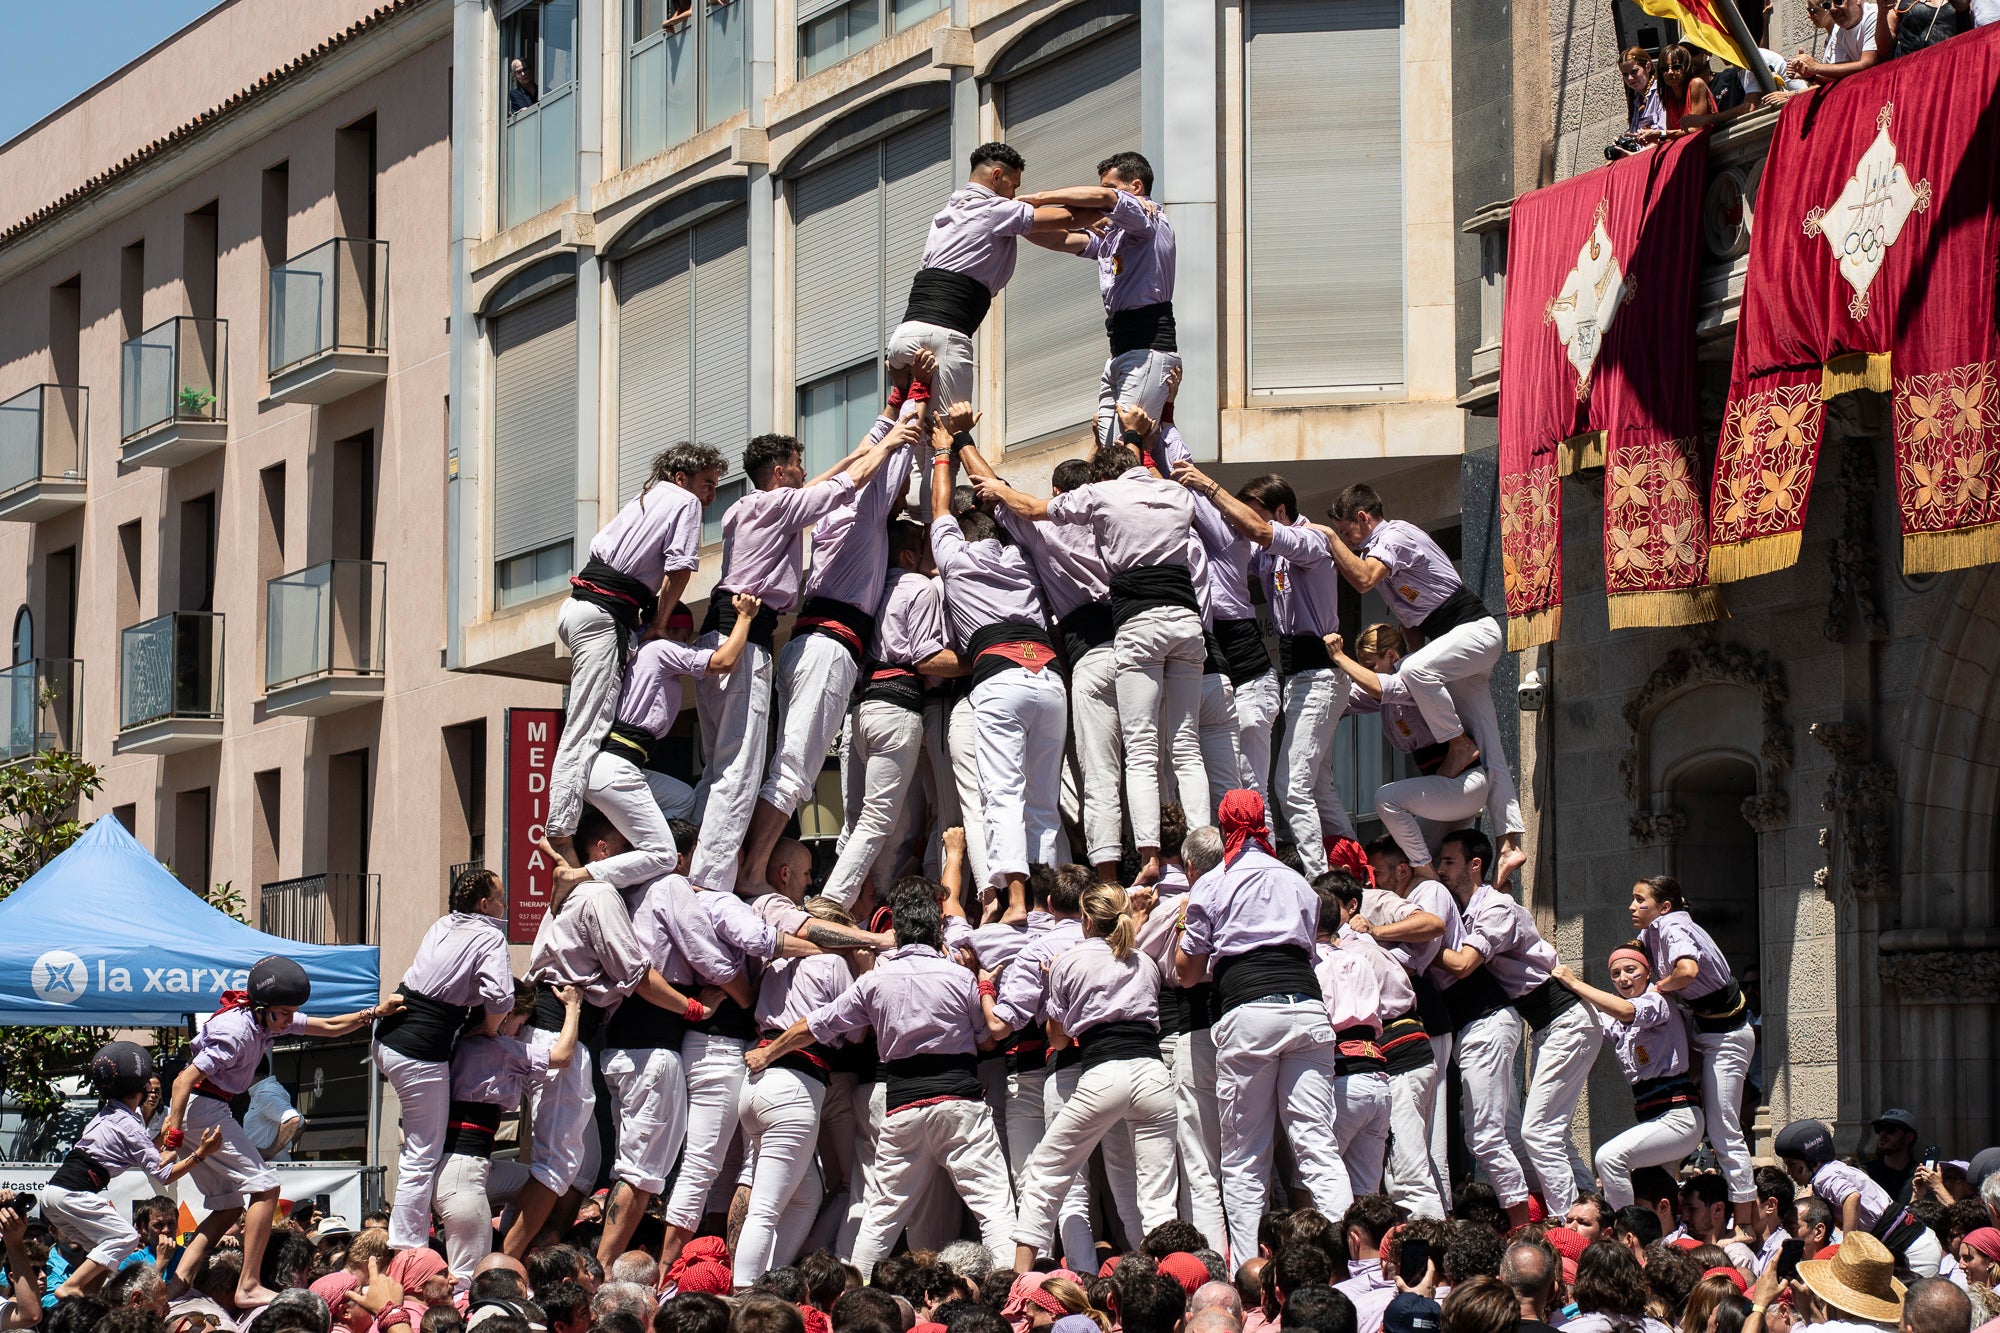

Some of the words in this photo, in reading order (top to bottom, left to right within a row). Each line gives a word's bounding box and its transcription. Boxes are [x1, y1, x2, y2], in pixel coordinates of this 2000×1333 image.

[528, 722, 547, 896] MEDICAL
[98, 959, 133, 993] la
[142, 967, 251, 993] xarxa
